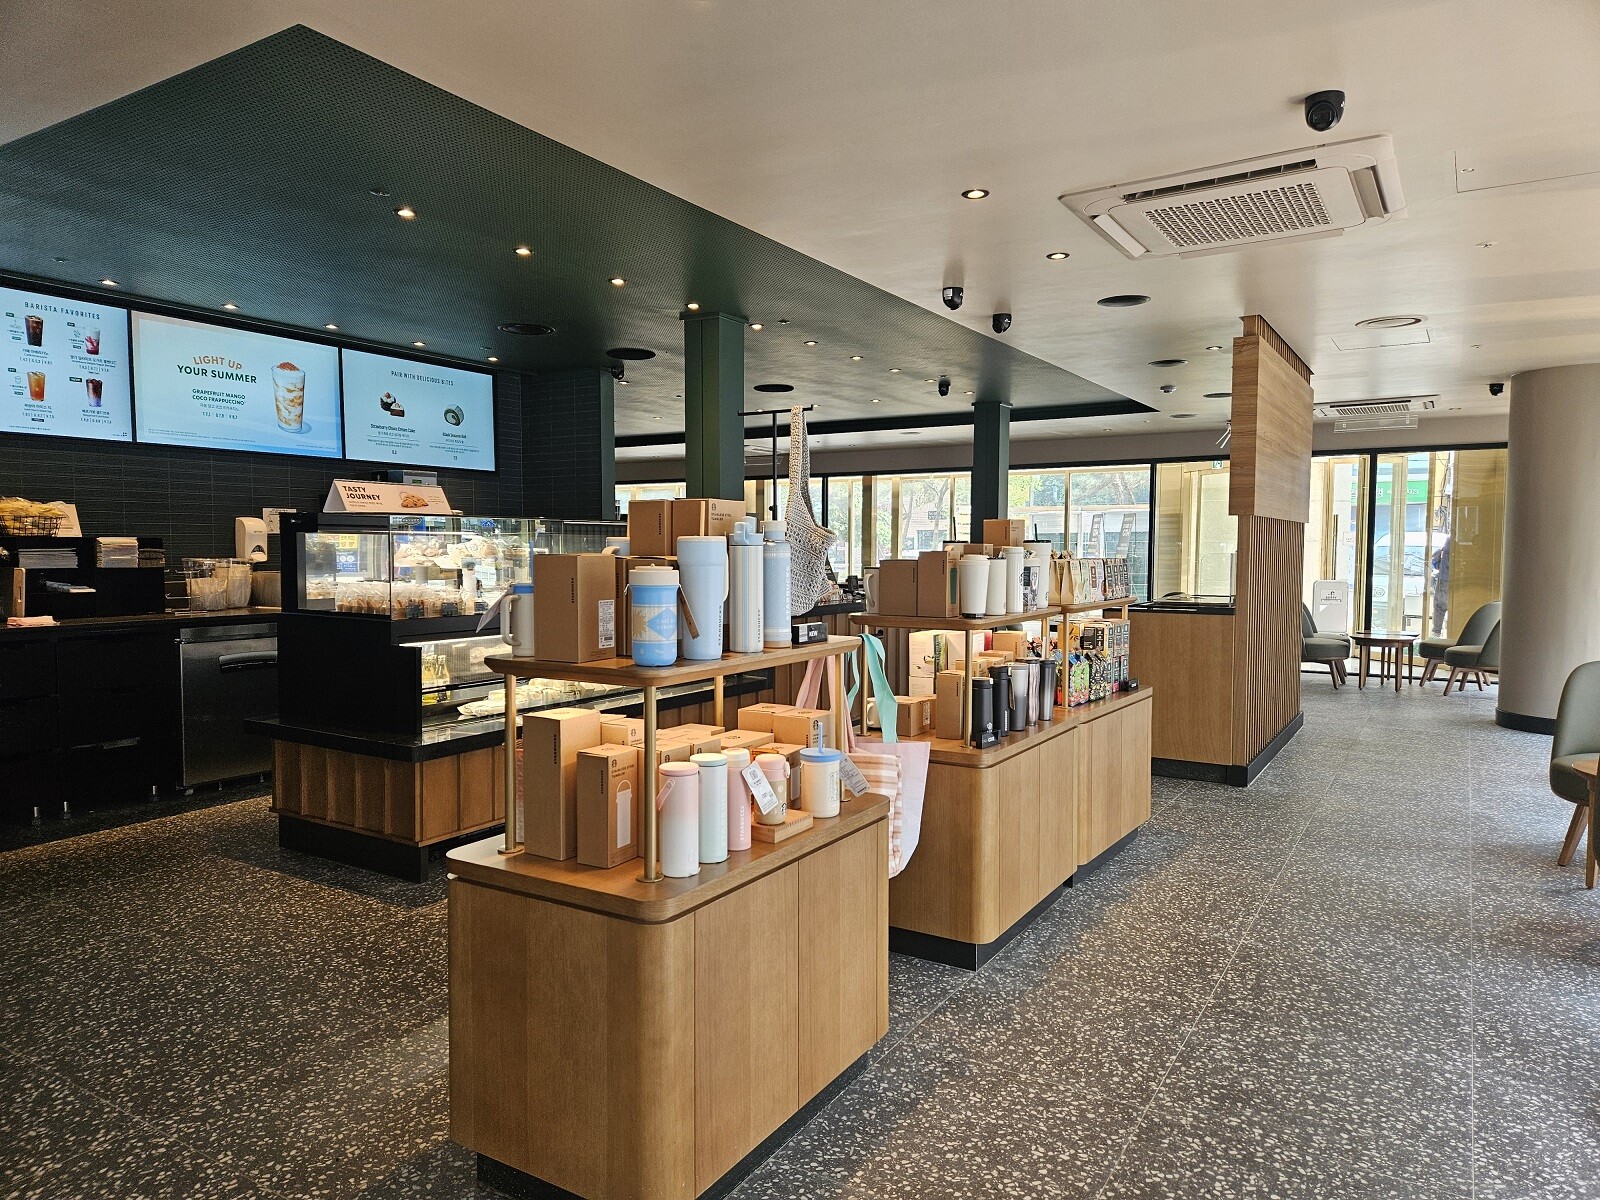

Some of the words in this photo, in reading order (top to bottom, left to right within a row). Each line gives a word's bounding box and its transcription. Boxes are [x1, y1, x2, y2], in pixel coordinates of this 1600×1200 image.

[24, 302, 58, 312] BARISTA
[60, 308, 100, 320] FAVORITES
[193, 356, 225, 366] LIGHT
[228, 360, 242, 370] UP
[177, 364, 208, 377] YOUR
[211, 370, 257, 384] SUMMER
[416, 374, 440, 384] DELICIOUS
[192, 388, 224, 396] GRAPEFRUIT
[346, 492, 380, 500] JOURNEY
